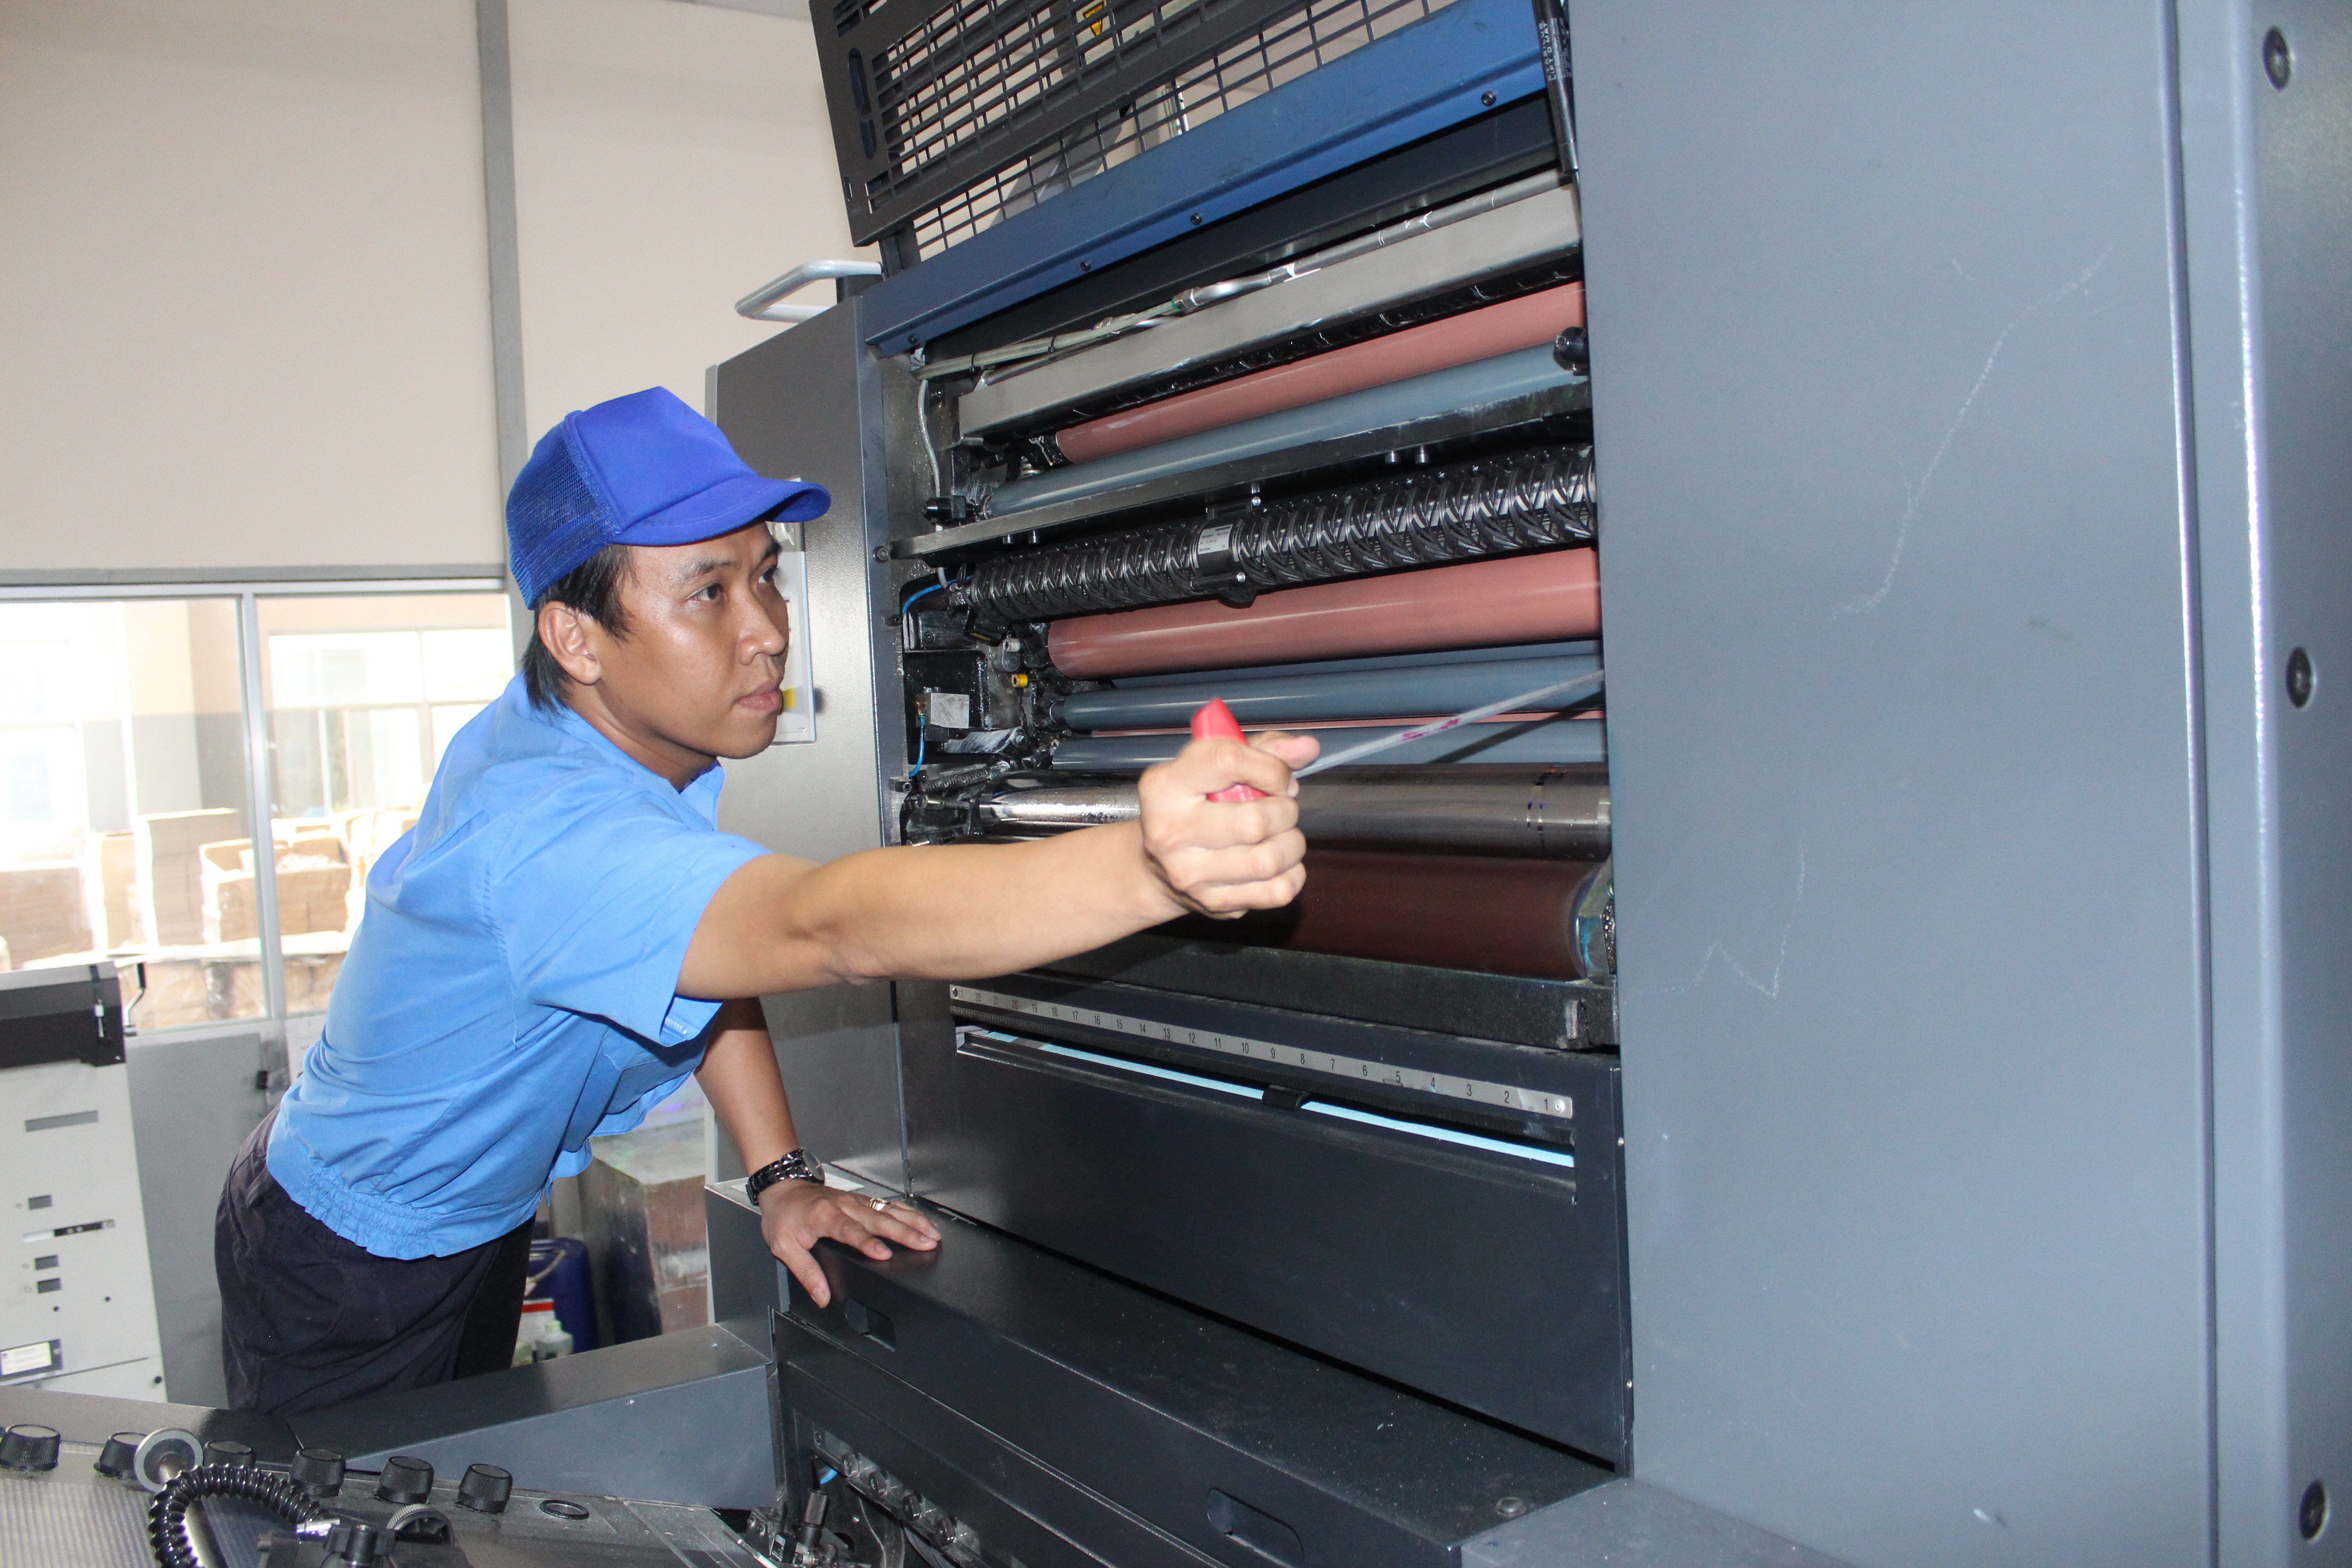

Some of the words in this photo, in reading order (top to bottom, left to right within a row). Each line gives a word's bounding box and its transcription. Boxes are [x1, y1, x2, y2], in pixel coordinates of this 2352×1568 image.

[975, 993, 981, 1002] 22
[1012, 1000, 1018, 1009] 20
[1032, 1003, 1037, 1013] 19
[1052, 1007, 1058, 1017] 18
[1073, 1011, 1078, 1020] 17
[1094, 1015, 1100, 1025] 16
[1117, 1019, 1123, 1029] 15
[1139, 1023, 1146, 1034] 14
[1163, 1028, 1171, 1038] 13
[1188, 1032, 1196, 1044] 12
[1214, 1038, 1221, 1048] 11
[1241, 1043, 1249, 1054] 10
[1271, 1047, 1275, 1059] 9
[1300, 1053, 1305, 1065] 8
[1330, 1058, 1335, 1070] 7
[1362, 1065, 1367, 1077] 6
[1396, 1071, 1401, 1083] 5
[1431, 1077, 1435, 1089] 4
[1466, 1084, 1472, 1096] 3
[1504, 1091, 1509, 1103] 2
[1544, 1098, 1548, 1111] 1
